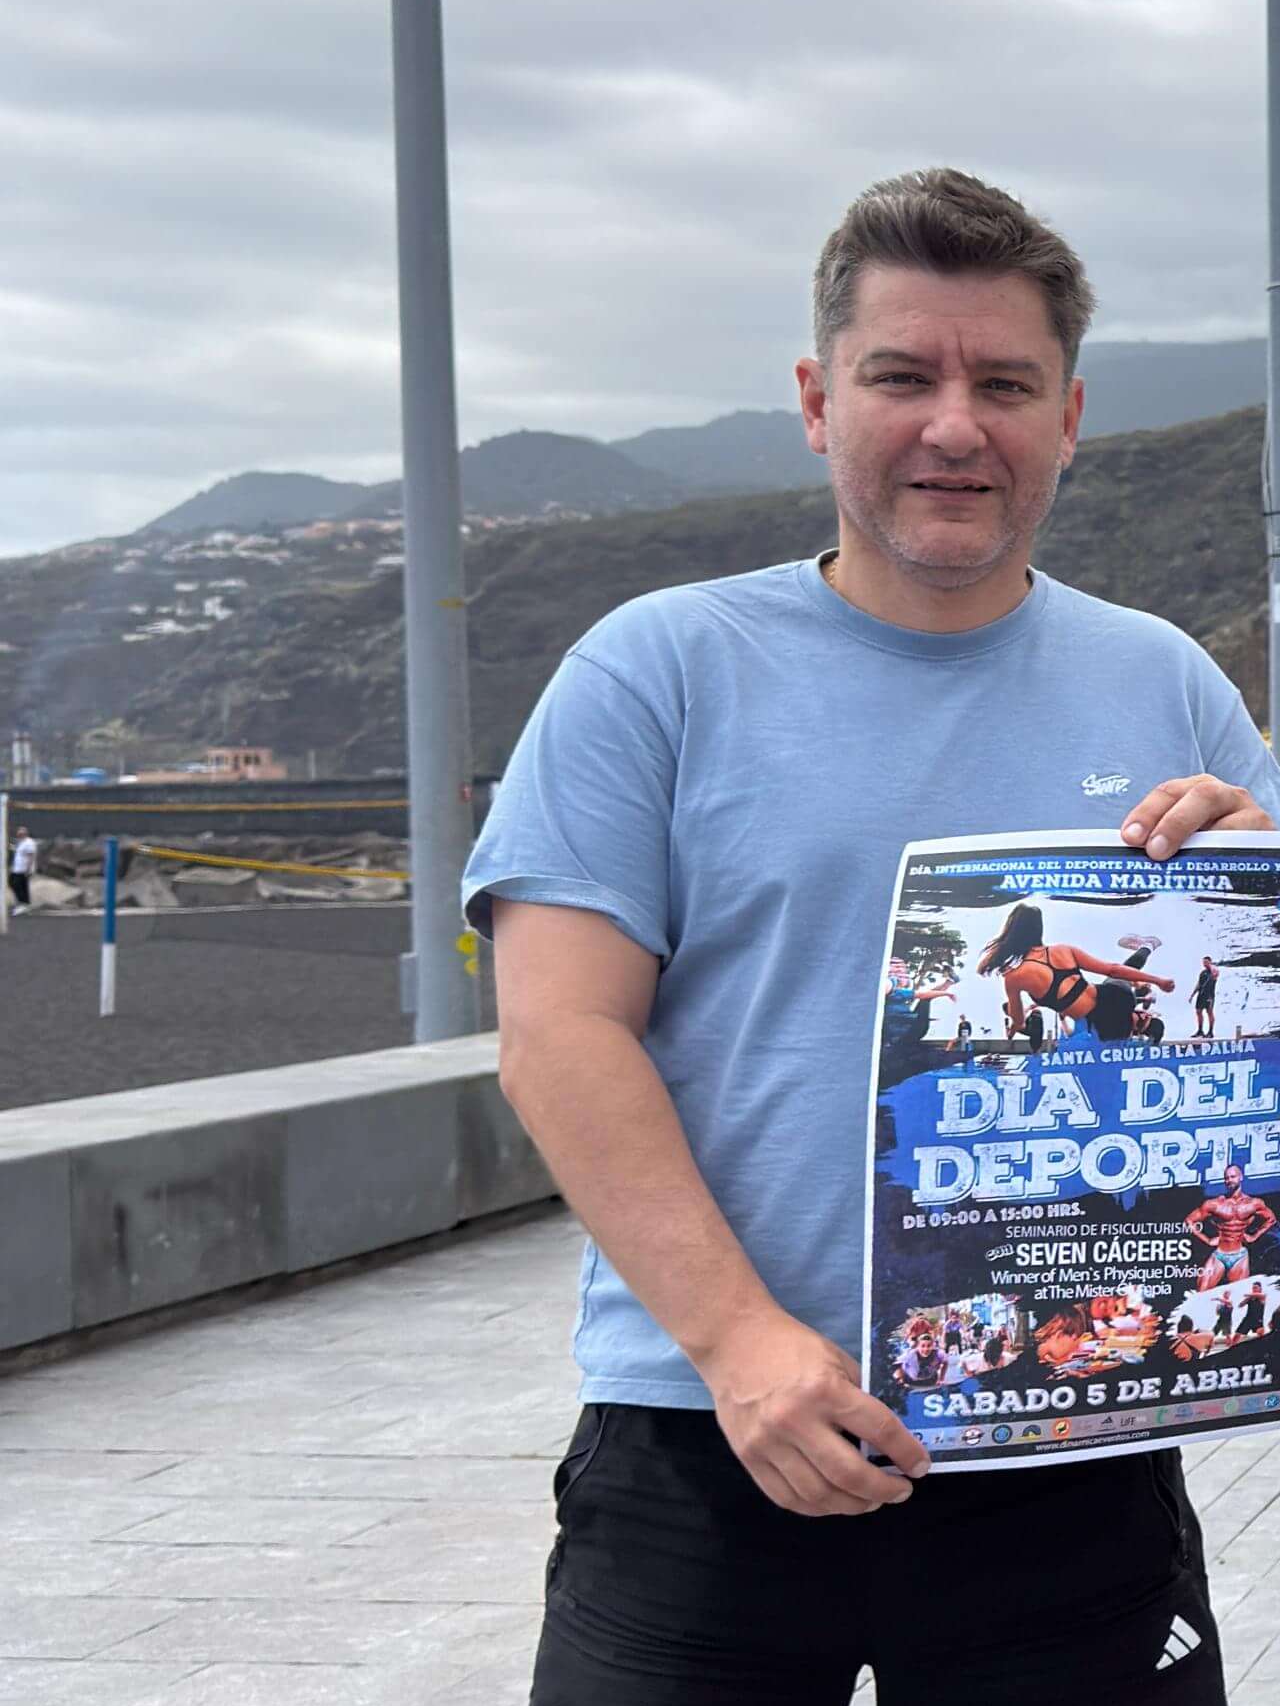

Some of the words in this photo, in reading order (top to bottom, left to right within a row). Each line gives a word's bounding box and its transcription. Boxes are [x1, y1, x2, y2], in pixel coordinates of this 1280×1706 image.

[909, 864, 932, 876] DÍA
[934, 860, 1034, 875] INTERNACIONAL
[1038, 860, 1061, 870] DEL
[1065, 860, 1123, 870] DEPORTE
[1126, 860, 1162, 870] PARA
[1167, 860, 1182, 871] EL
[1187, 861, 1270, 872] DESARROLLO
[1000, 874, 1102, 890] AVENIDA
[1110, 871, 1234, 891] MARÍTIMA
[1041, 1050, 1095, 1067] SANTA
[1100, 1047, 1145, 1064] CRUZ
[1149, 1045, 1171, 1060] DE
[1174, 1042, 1197, 1059] LA
[1200, 1041, 1257, 1057] PALMA
[936, 1059, 1100, 1138] DÍA
[1119, 1059, 1280, 1127] DEL
[903, 1214, 925, 1229] DE
[929, 1210, 981, 1227] 09:00
[984, 1209, 998, 1223] A
[1000, 1204, 1044, 1222] 15:00
[1047, 1202, 1086, 1218] HRS.
[1006, 1224, 1078, 1239] SEMINARIO
[1081, 1224, 1098, 1237] DE
[1100, 1221, 1204, 1236] FISICULTURISMO
[1016, 1241, 1086, 1266] SEVEN
[1093, 1236, 1192, 1263] CÁCERES
[991, 1269, 1041, 1285] Winner
[1041, 1266, 1057, 1283] of
[1103, 1264, 1163, 1283] Physique
[1164, 1264, 1213, 1279] Division
[1034, 1287, 1048, 1301] at
[1048, 1284, 1074, 1300] The
[1075, 1283, 1117, 1298] Mister
[923, 1386, 1077, 1418] SABADO
[1086, 1380, 1111, 1406] 5
[1115, 1377, 1161, 1403] DE
[1170, 1363, 1273, 1396] ABRIL
